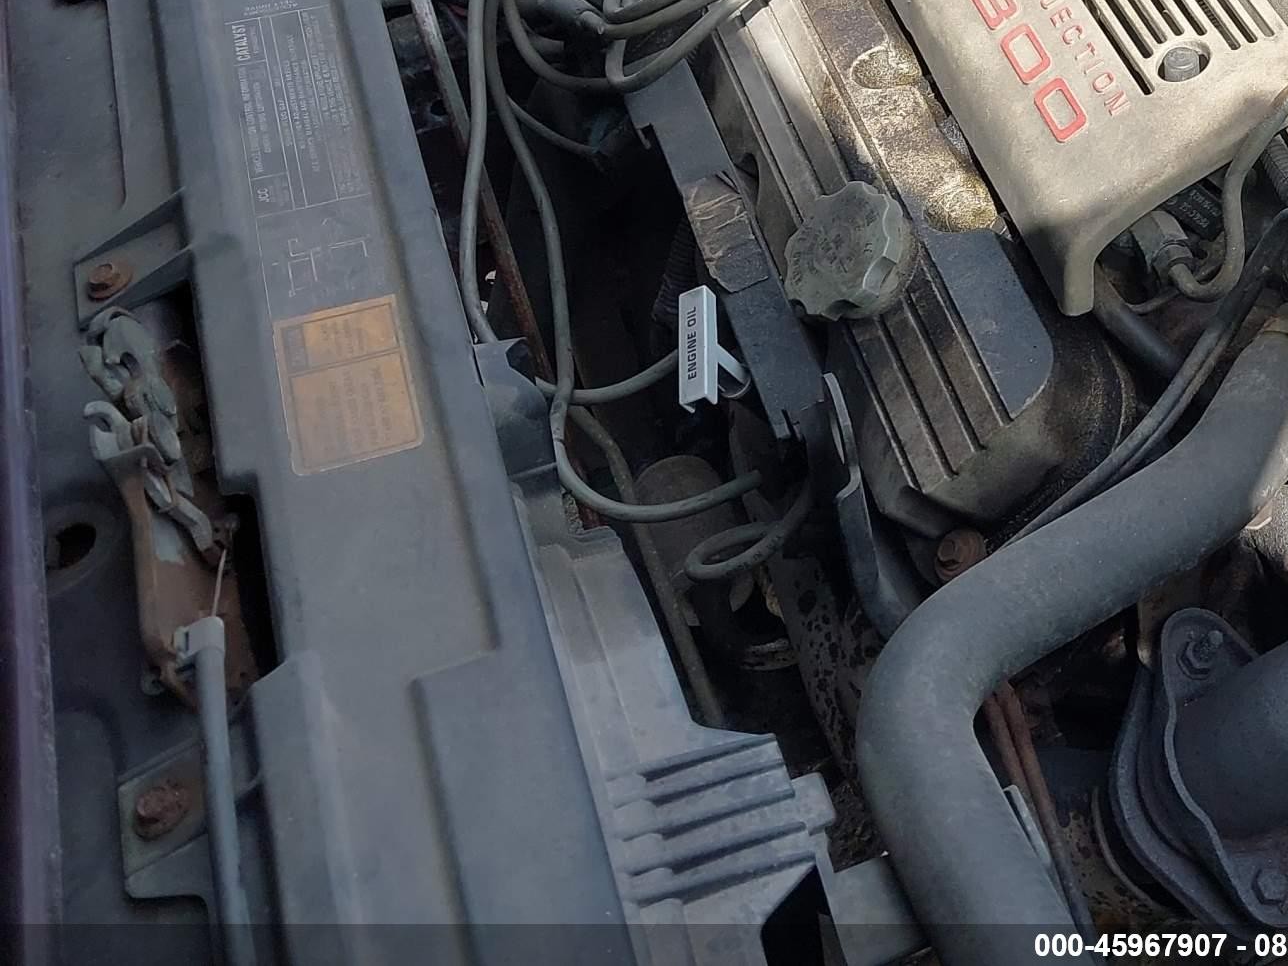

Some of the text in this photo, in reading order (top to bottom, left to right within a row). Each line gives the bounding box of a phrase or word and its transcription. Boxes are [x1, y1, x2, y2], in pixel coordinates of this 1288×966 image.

[231, 24, 251, 62] CATALYST
[686, 305, 697, 381] ENGINE OIL
